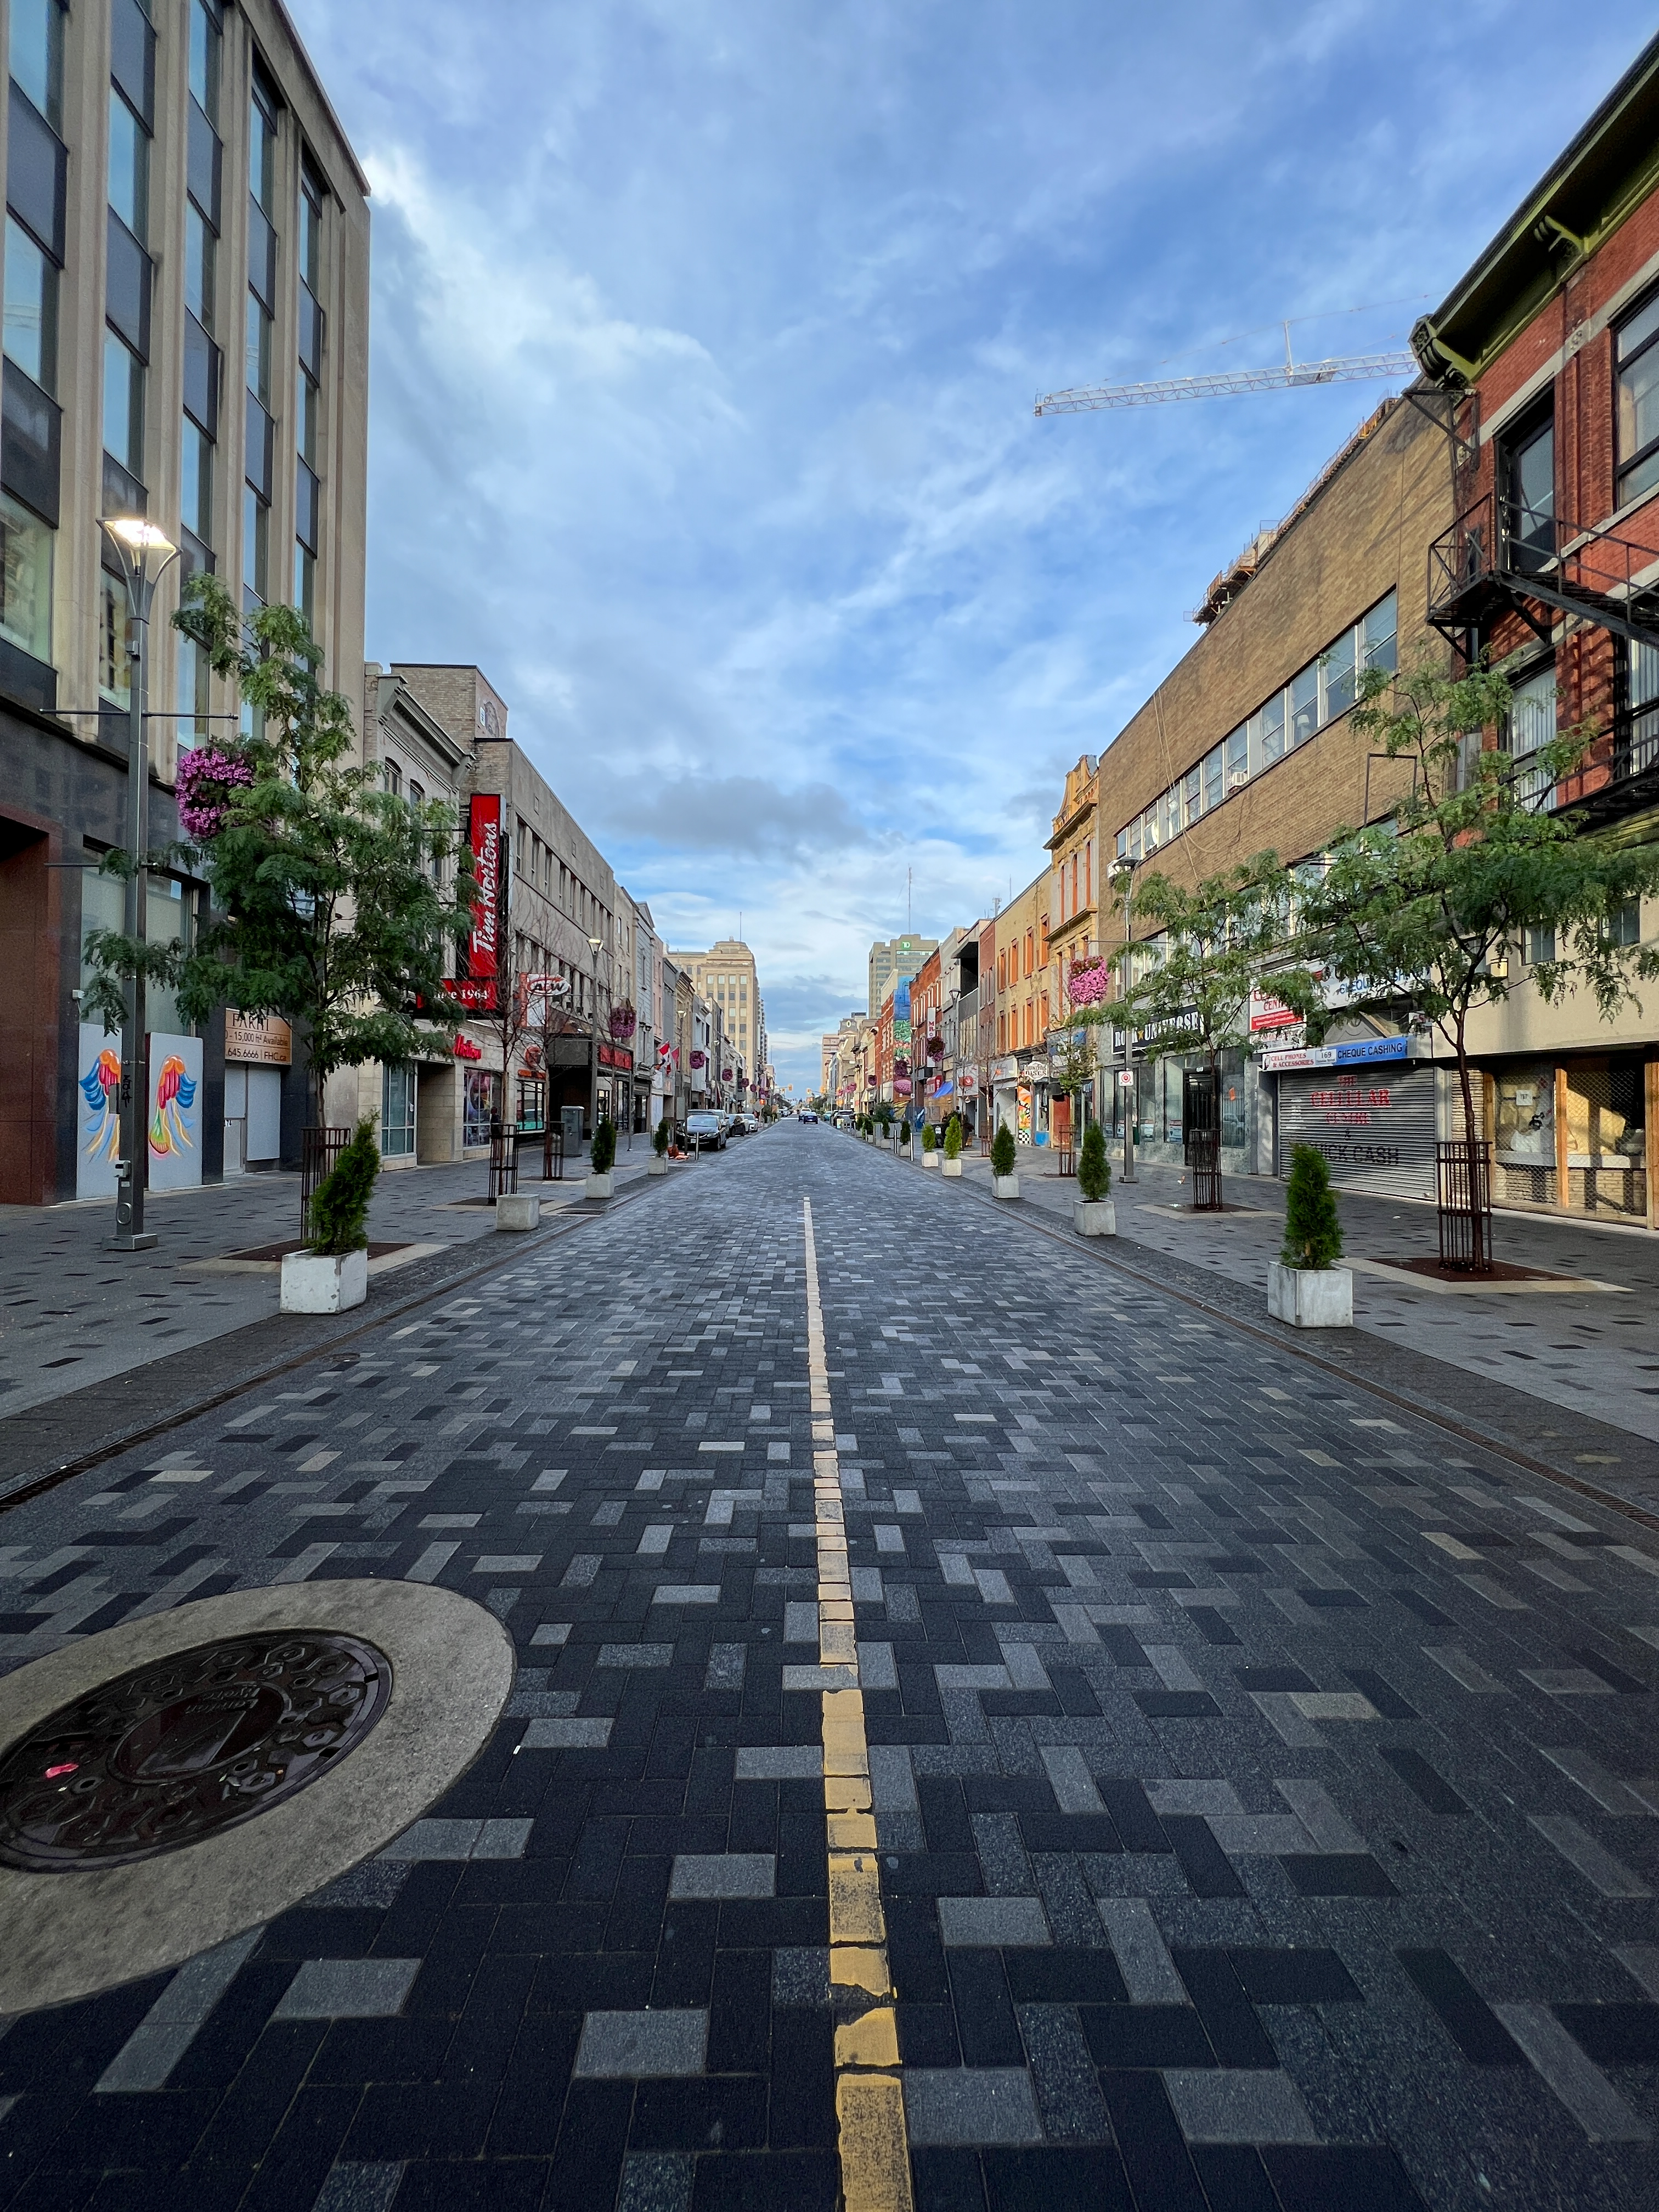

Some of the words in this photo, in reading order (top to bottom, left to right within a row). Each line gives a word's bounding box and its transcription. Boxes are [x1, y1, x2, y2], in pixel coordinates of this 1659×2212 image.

[477, 822, 497, 906] Hortons
[472, 913, 495, 953] Tim
[461, 989, 487, 1000] 1964
[234, 1031, 254, 1042] 15,000
[263, 1035, 288, 1046] Available
[1115, 1026, 1138, 1047] ROK
[264, 1051, 287, 1062] FHC.ca
[1338, 1047, 1366, 1059] CHEQUE
[1368, 1043, 1402, 1056] CASHING
[1279, 1059, 1314, 1068] ACCESSORIES
[1310, 1088, 1391, 1108] CELLULAR
[1353, 1146, 1399, 1164] CASH
